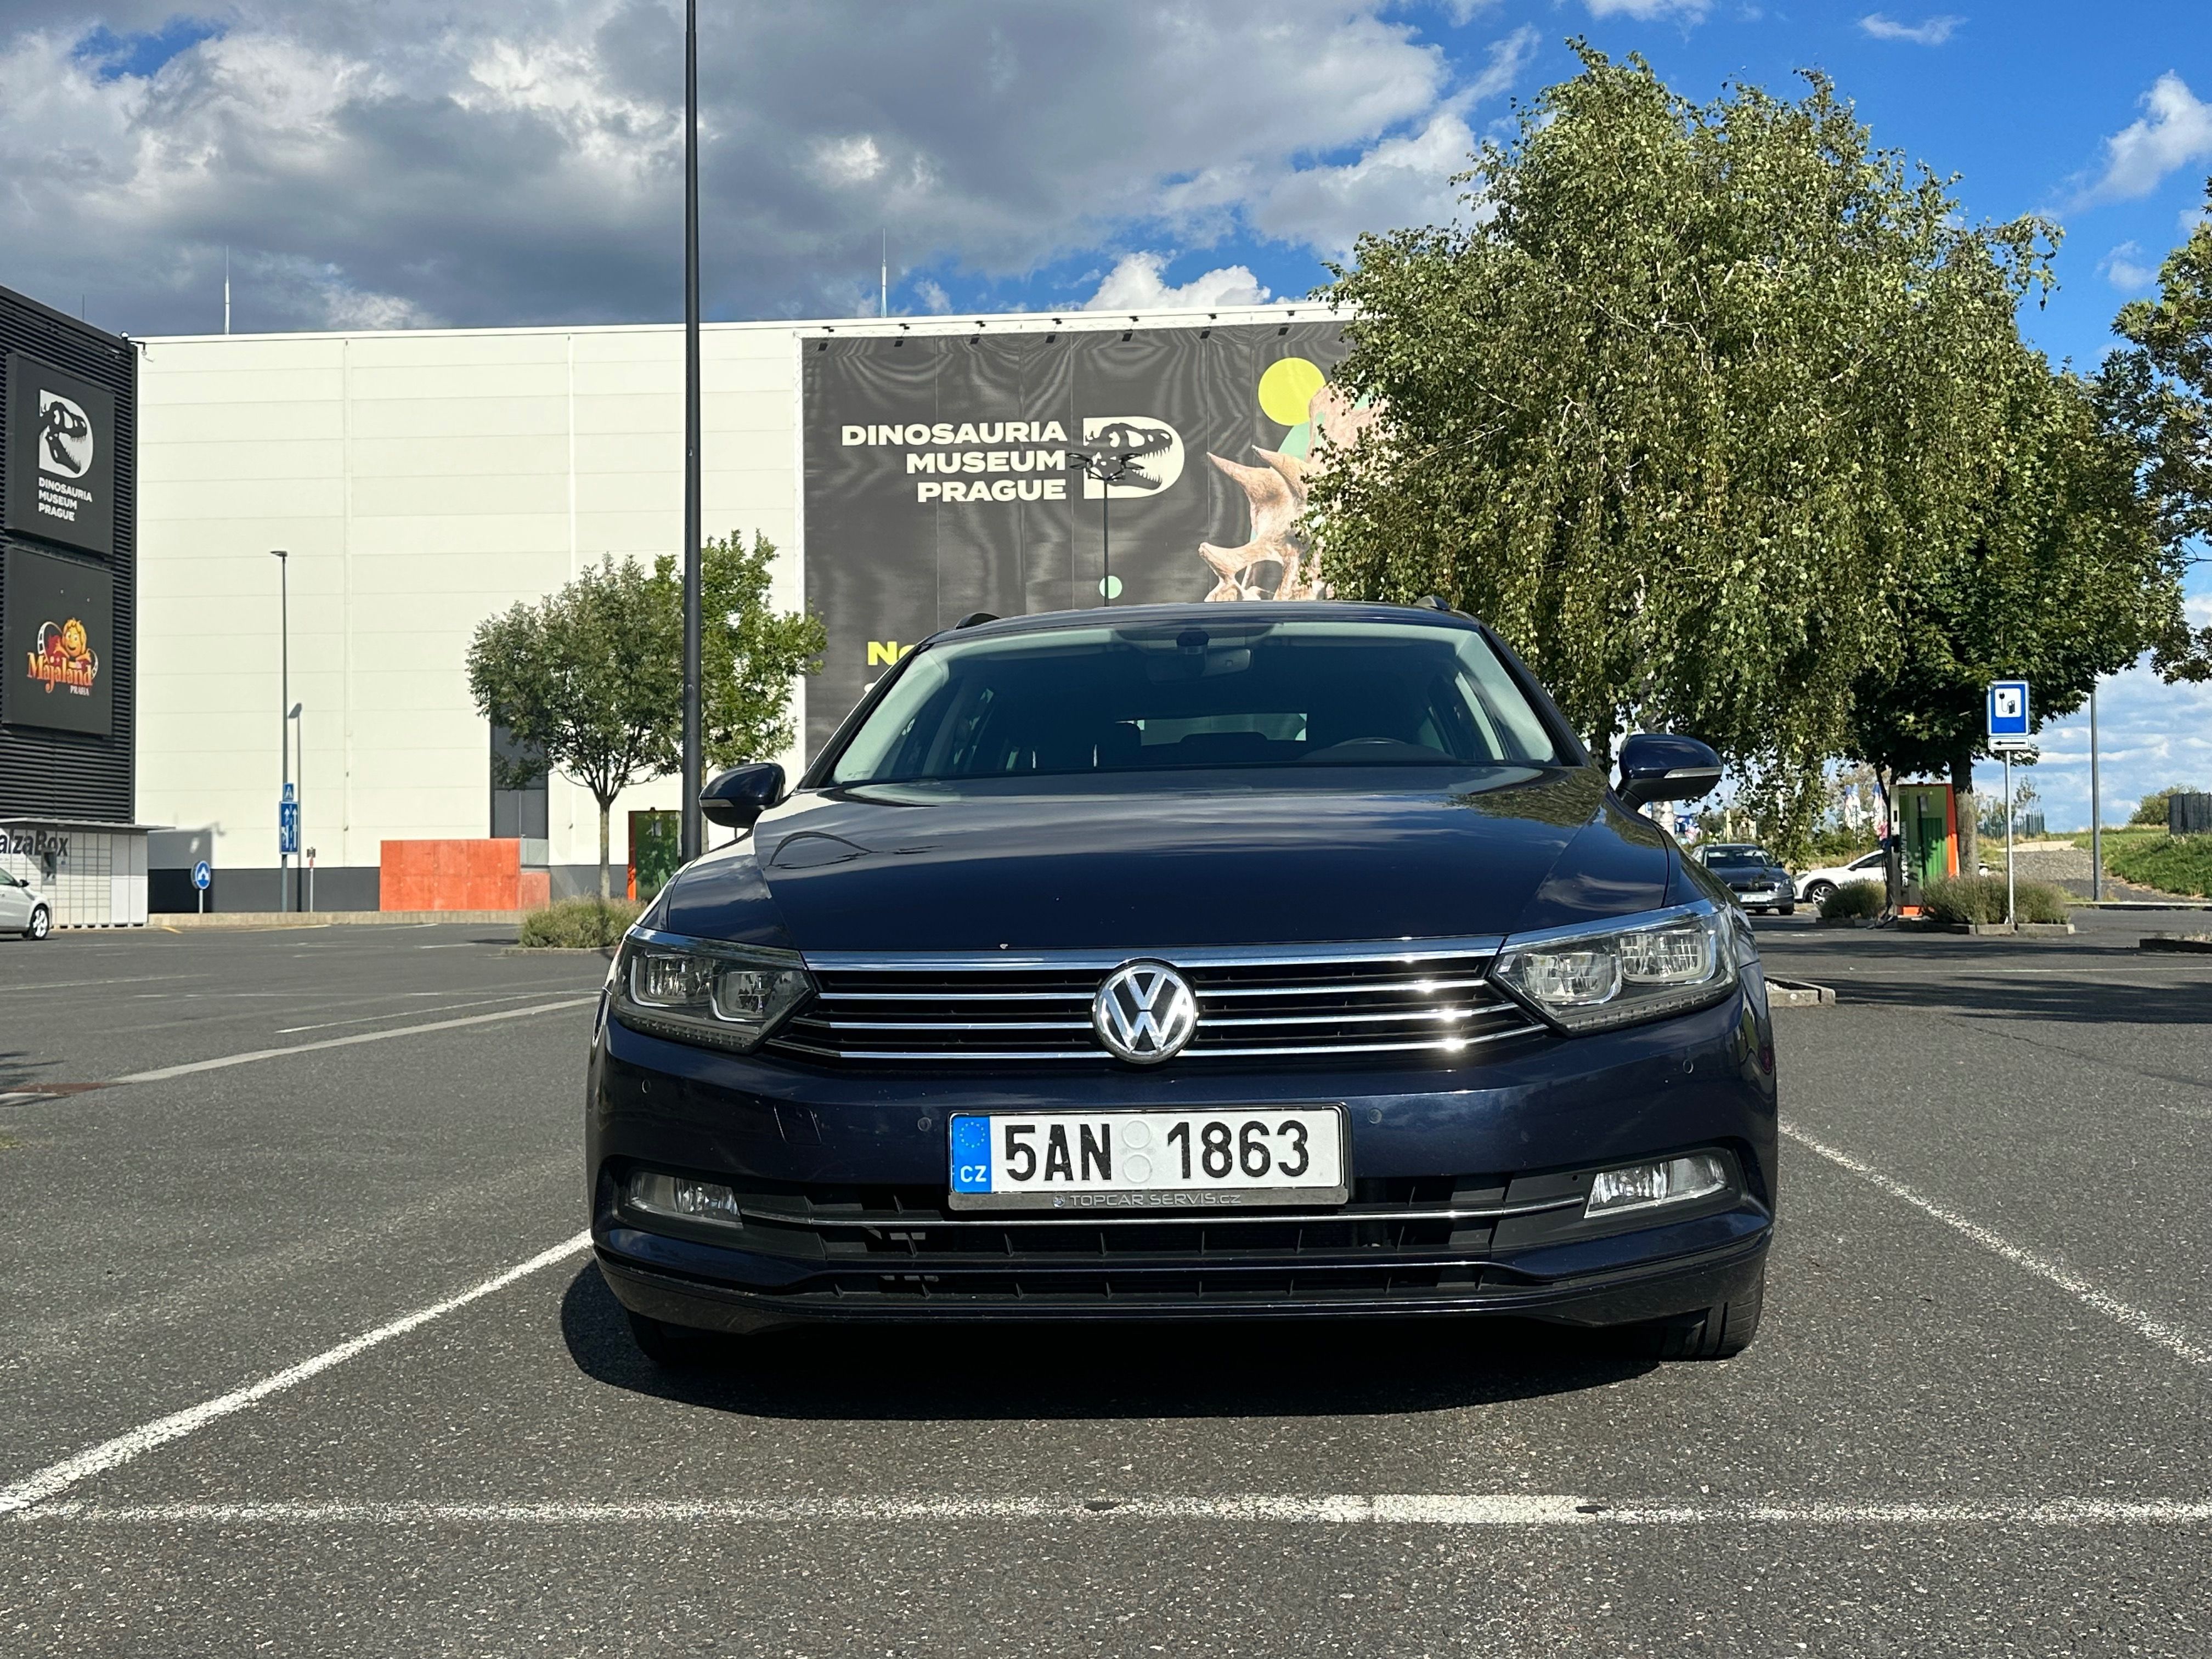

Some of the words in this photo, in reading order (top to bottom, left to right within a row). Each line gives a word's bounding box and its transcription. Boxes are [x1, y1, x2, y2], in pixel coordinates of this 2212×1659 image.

[842, 421, 1068, 446] DINOSAURIA
[906, 450, 1065, 474] MUSEUM
[38, 477, 93, 503] DINOSAURIA
[38, 489, 77, 510] MUSEUM
[917, 479, 1066, 503] PRAGUE
[38, 502, 75, 522] PRAGUE
[26, 652, 93, 693] Majaland
[1005, 1124, 1111, 1181] 5AN
[1167, 1120, 1309, 1178] 1863
[961, 1165, 986, 1182] CZ
[1070, 1194, 1143, 1206] TOPCAR
